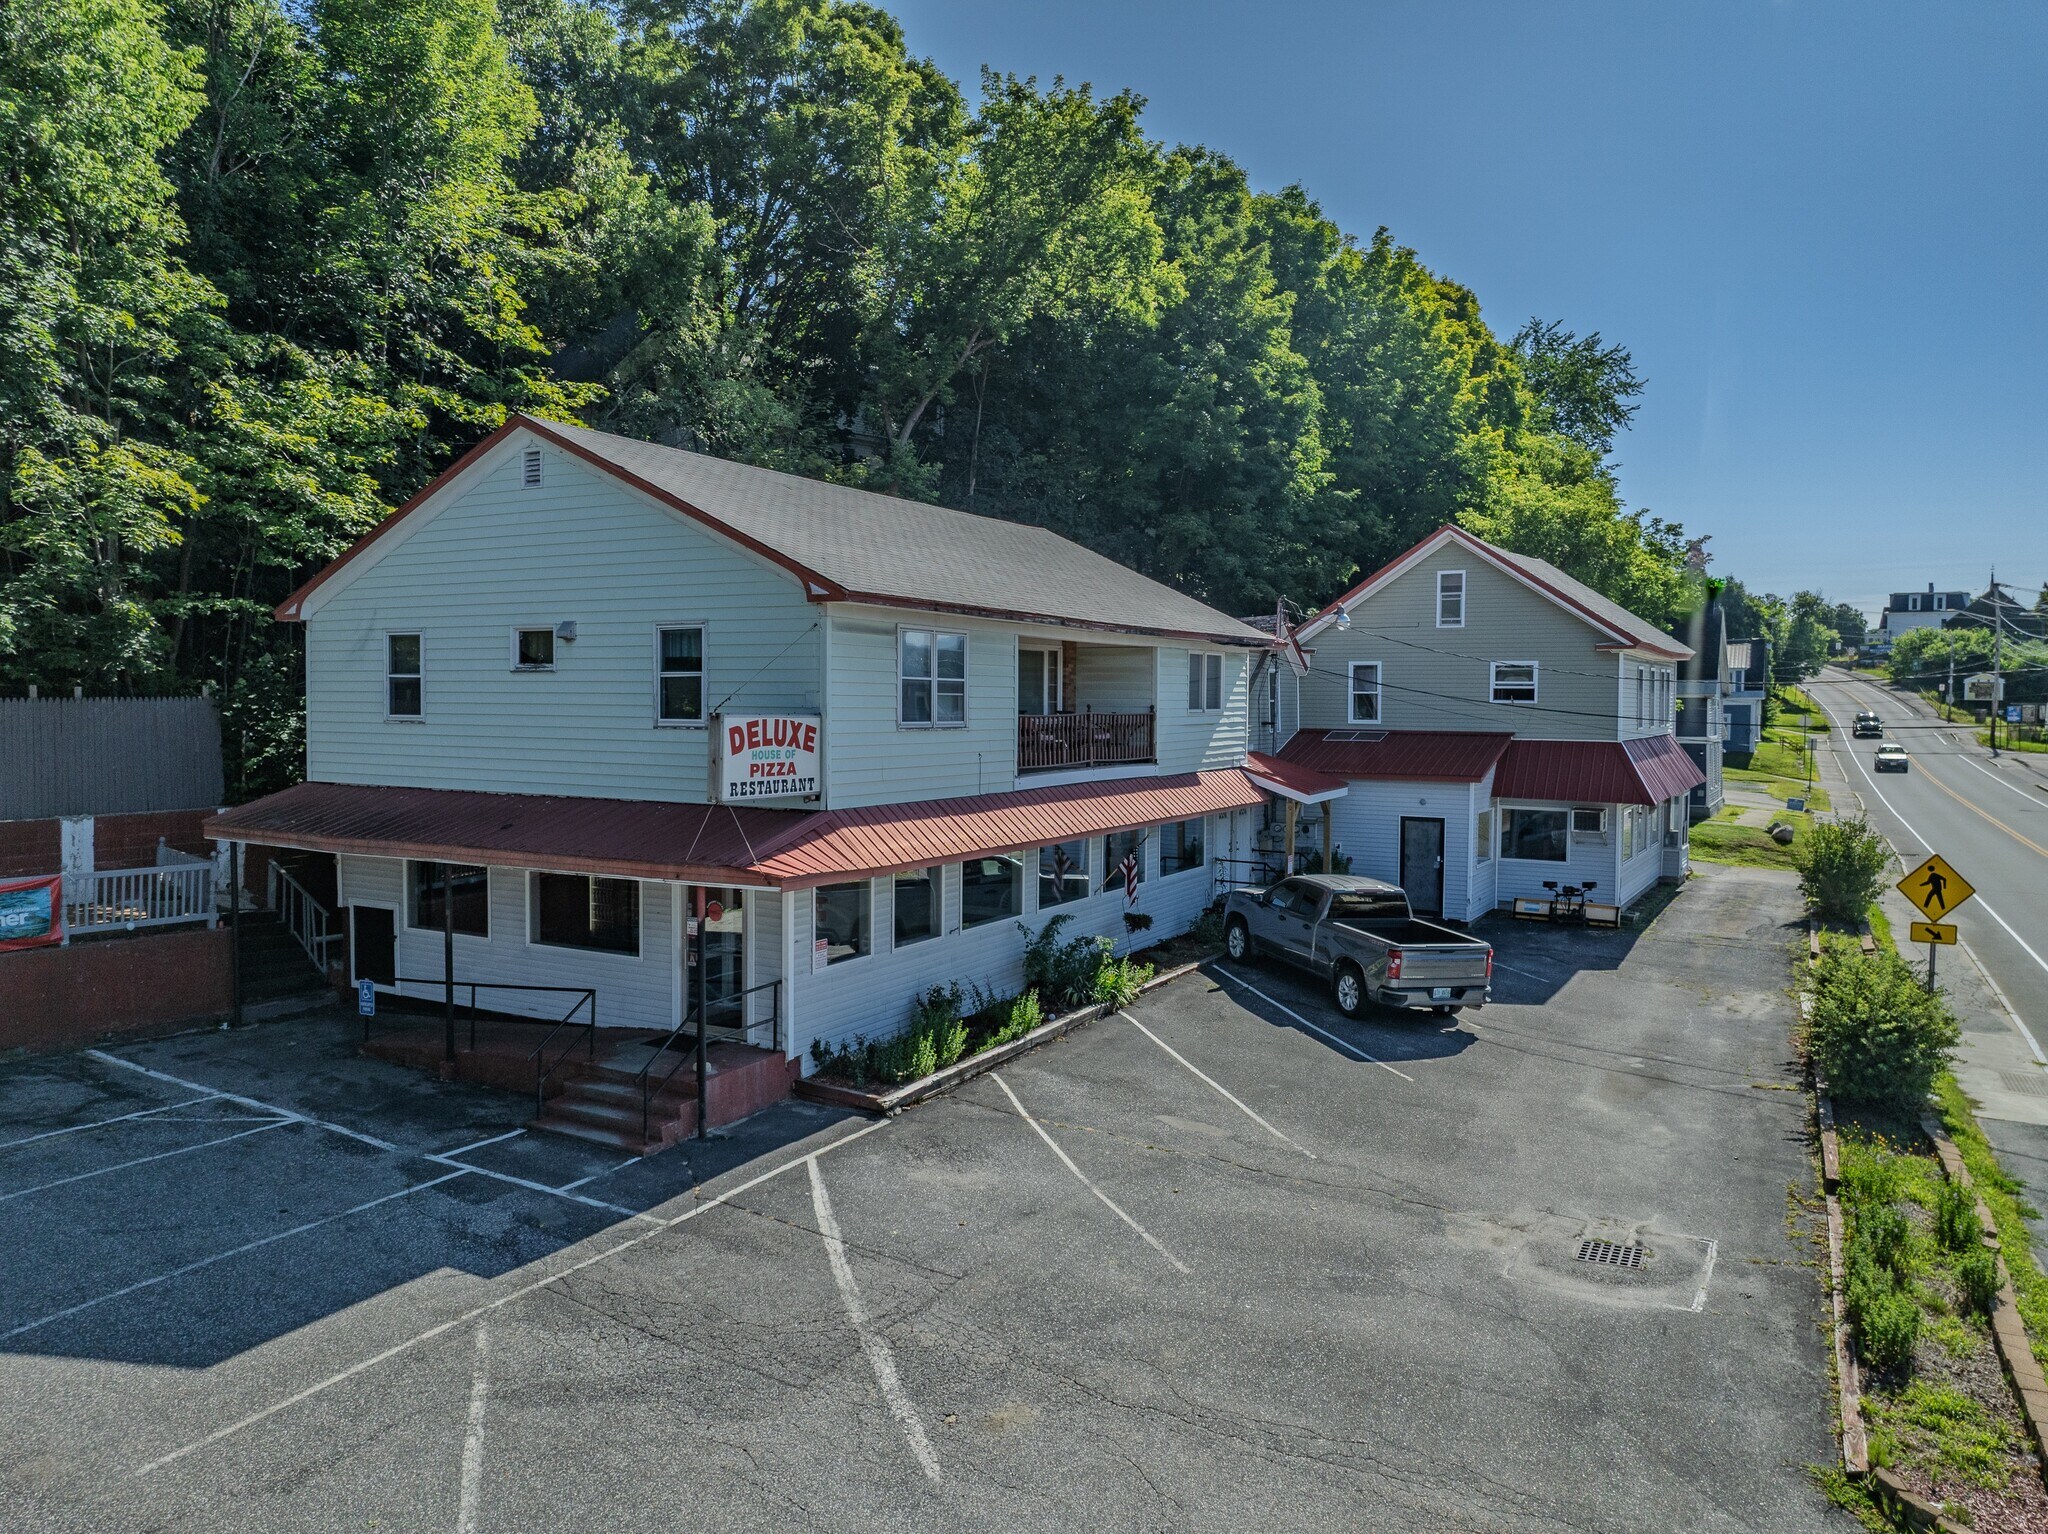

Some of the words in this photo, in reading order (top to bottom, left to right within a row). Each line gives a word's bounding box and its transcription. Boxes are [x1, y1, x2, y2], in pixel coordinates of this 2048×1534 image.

[728, 718, 817, 756] DELUXE
[751, 750, 781, 760] HOUSE
[785, 749, 796, 760] OF
[749, 762, 797, 778] PIZZA
[730, 777, 815, 797] RESTAURANT
